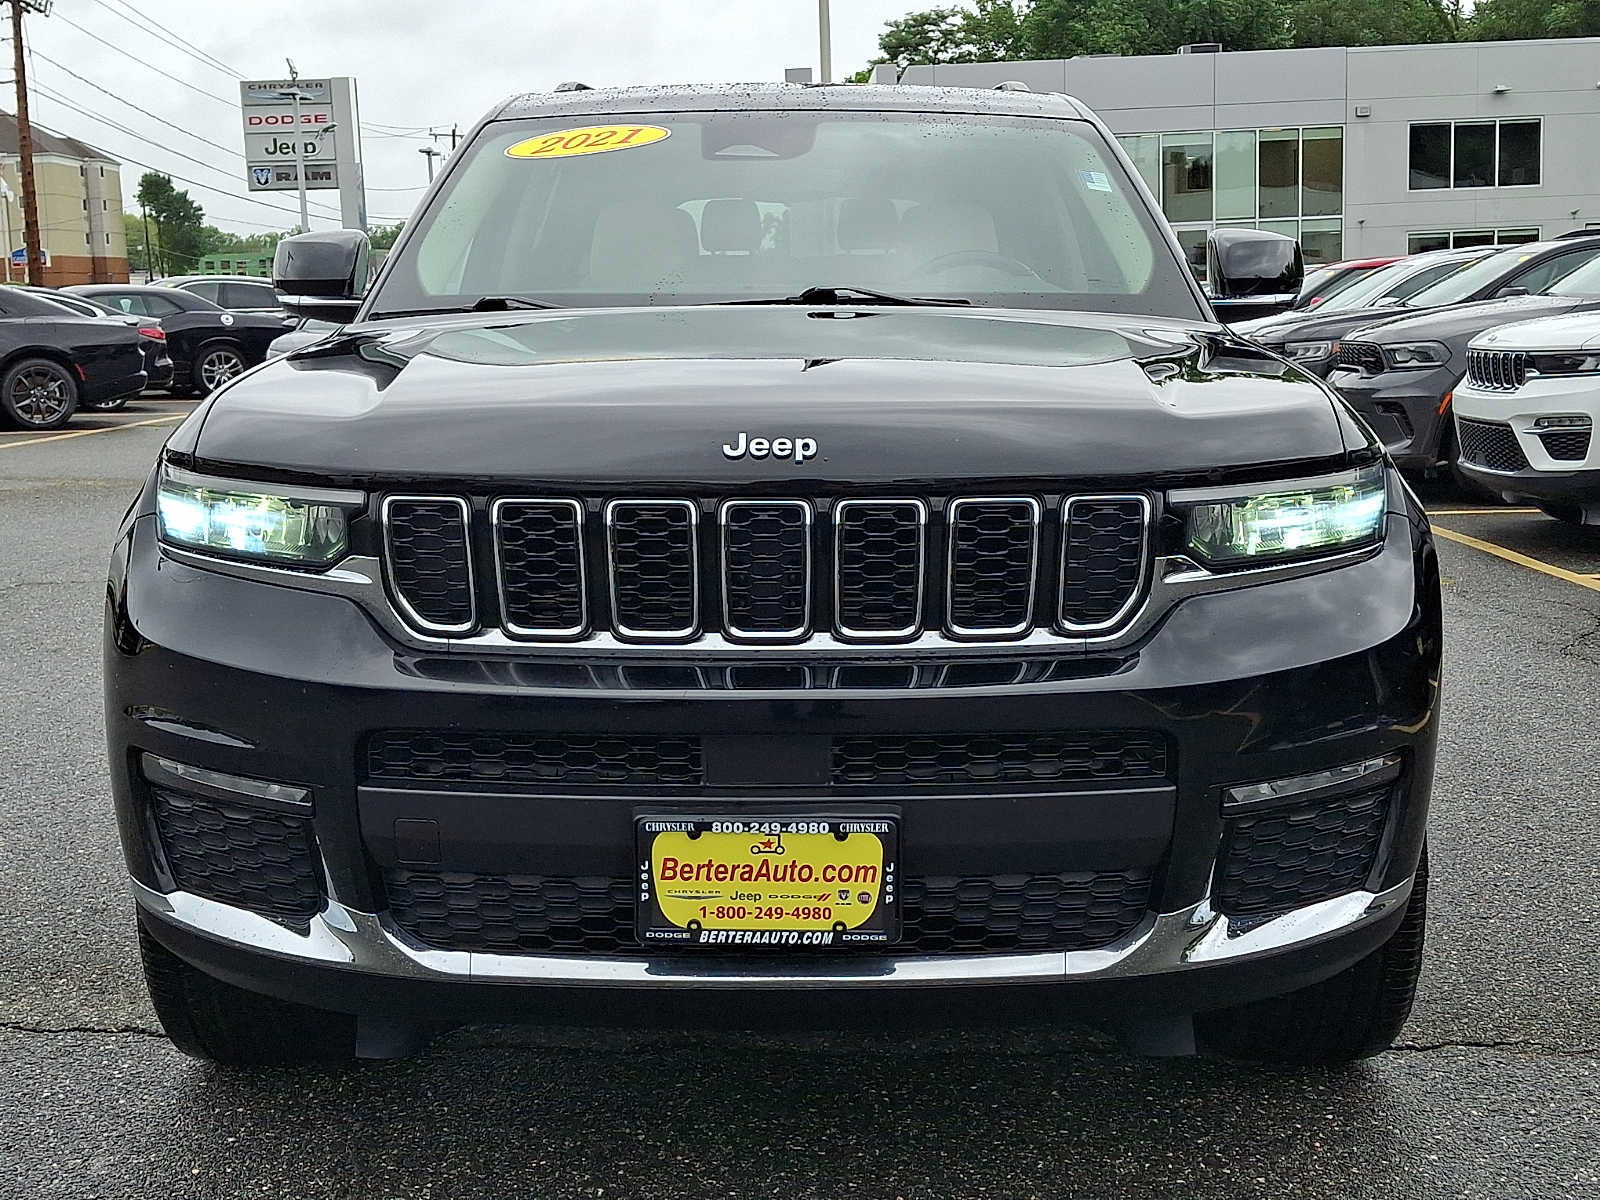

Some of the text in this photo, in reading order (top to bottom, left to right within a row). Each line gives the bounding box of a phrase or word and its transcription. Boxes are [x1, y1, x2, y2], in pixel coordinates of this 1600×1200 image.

[248, 82, 323, 90] CHRYSLER
[248, 114, 328, 126] DODGE
[531, 128, 643, 155] 2021
[722, 432, 818, 464] Jeep
[645, 822, 695, 832] CHRYSLER
[711, 822, 830, 834] 800-249-4980
[839, 823, 889, 833] CHRYSLER
[660, 857, 878, 883] BerteraAuto.com
[640, 860, 650, 902] Jeep
[885, 862, 895, 905] Jeep
[729, 890, 762, 902] Jeep
[699, 906, 832, 920] 1-800-249-4980
[646, 931, 691, 939] DODGE
[699, 930, 834, 945] BERTERAAUTO.COM
